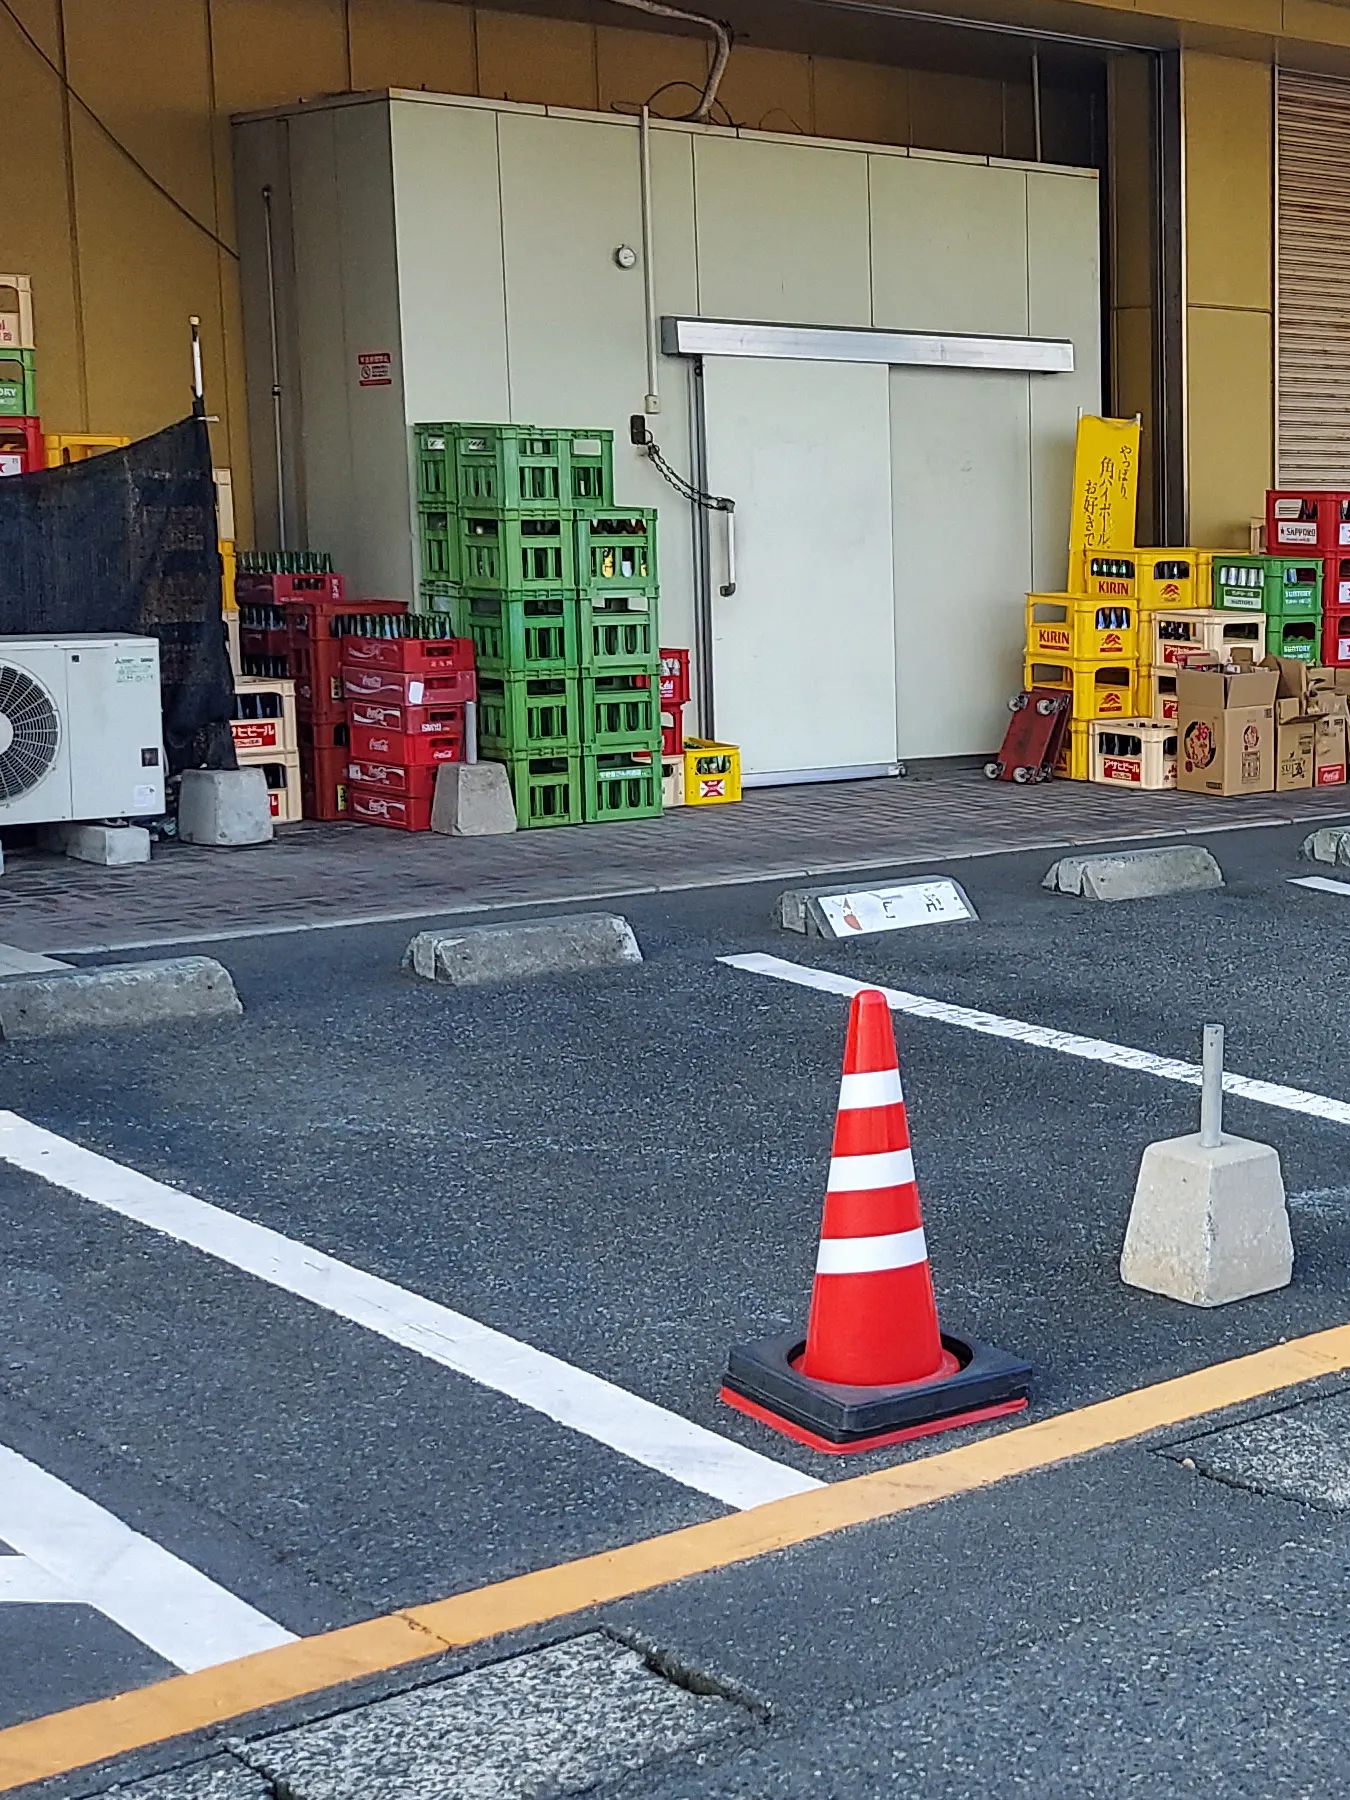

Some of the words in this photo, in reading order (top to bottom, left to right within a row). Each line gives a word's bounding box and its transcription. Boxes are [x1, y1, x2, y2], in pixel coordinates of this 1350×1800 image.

[1098, 580, 1129, 595] KIRIN
[1039, 629, 1070, 645] KIRIN
[231, 724, 275, 738] ヒビール
